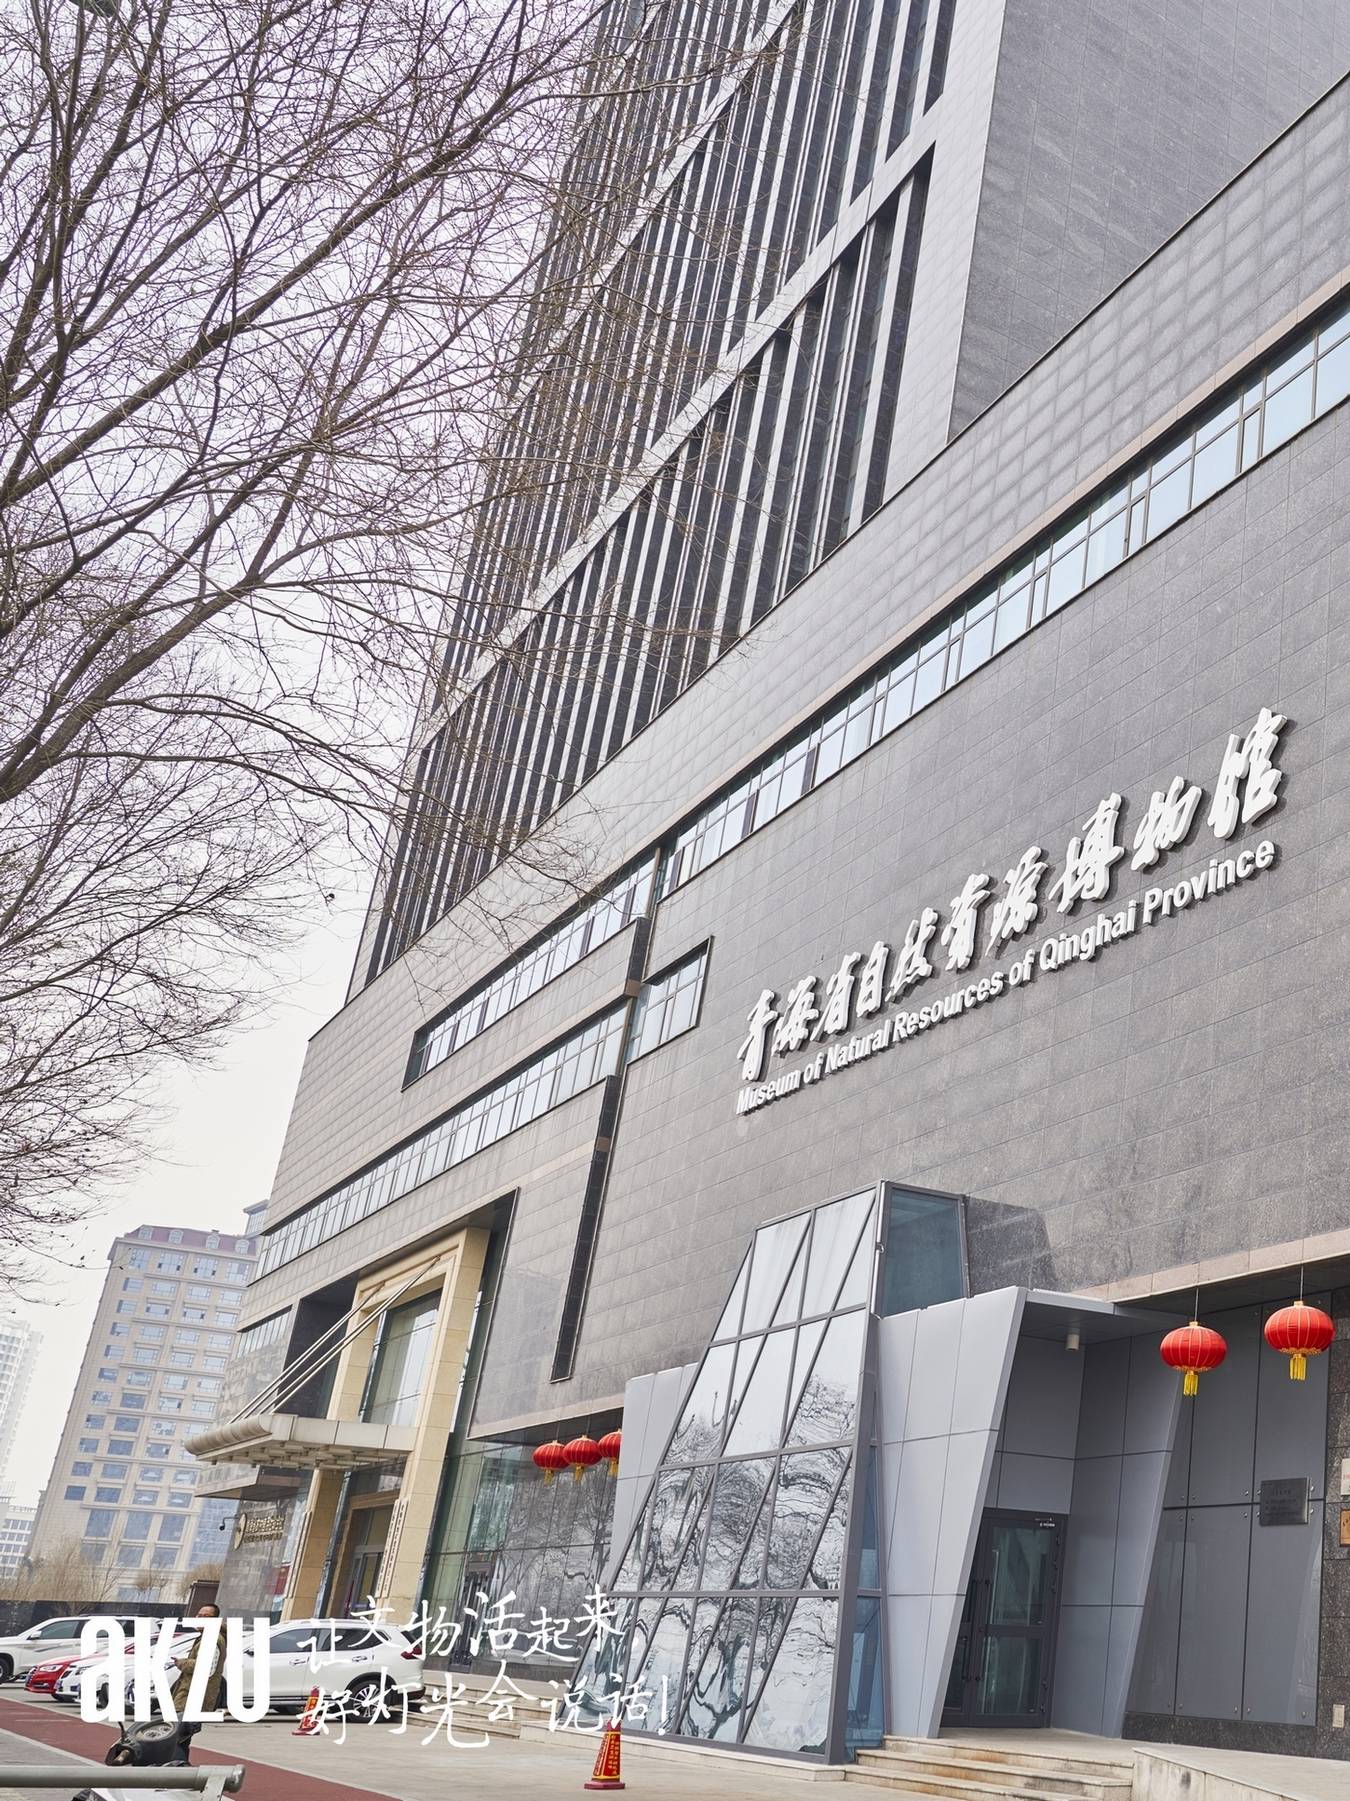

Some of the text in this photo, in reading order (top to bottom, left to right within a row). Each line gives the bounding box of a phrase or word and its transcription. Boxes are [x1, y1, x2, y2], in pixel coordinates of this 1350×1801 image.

[736, 840, 1276, 1115] Museum of Natural Resources of Qinghai Province
